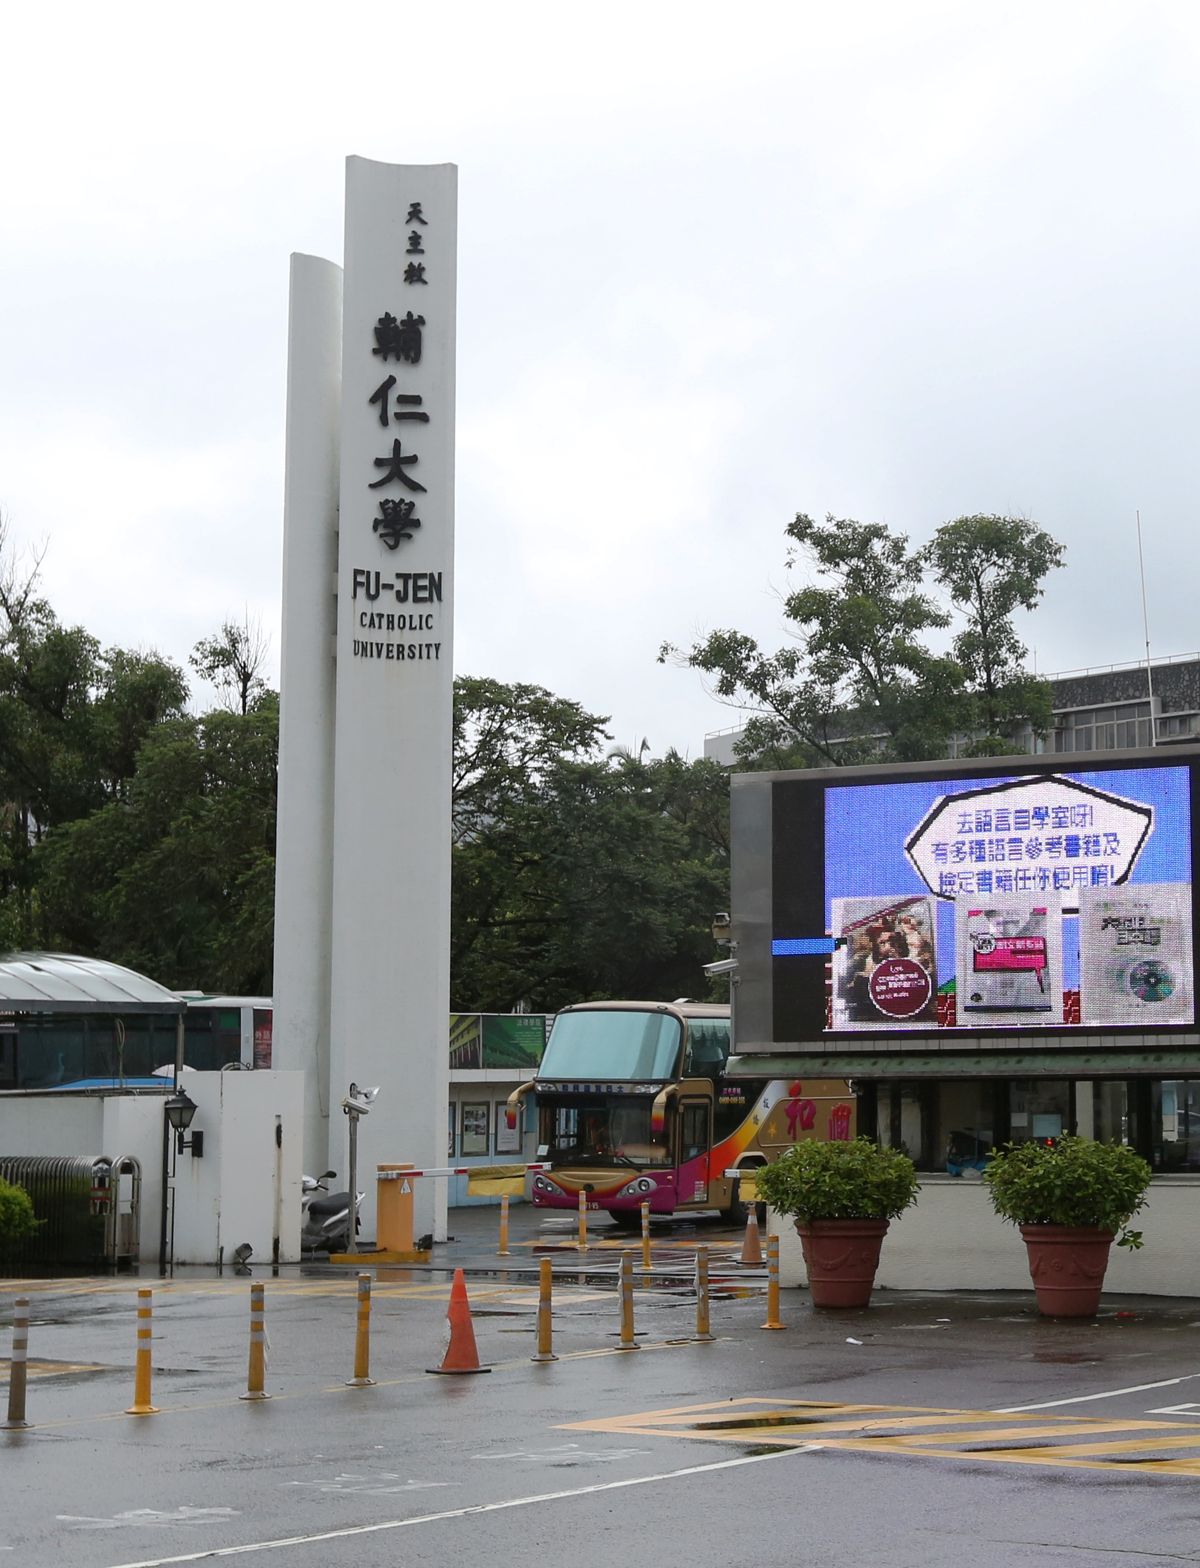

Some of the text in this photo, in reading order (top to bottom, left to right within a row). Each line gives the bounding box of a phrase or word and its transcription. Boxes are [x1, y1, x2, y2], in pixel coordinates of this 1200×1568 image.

[405, 202, 428, 285] 天主教
[369, 311, 430, 550] 輔仁大學
[353, 568, 443, 604] FU-JEN
[360, 612, 433, 630] CATHOLIC
[353, 639, 441, 660] UNIVERSITY
